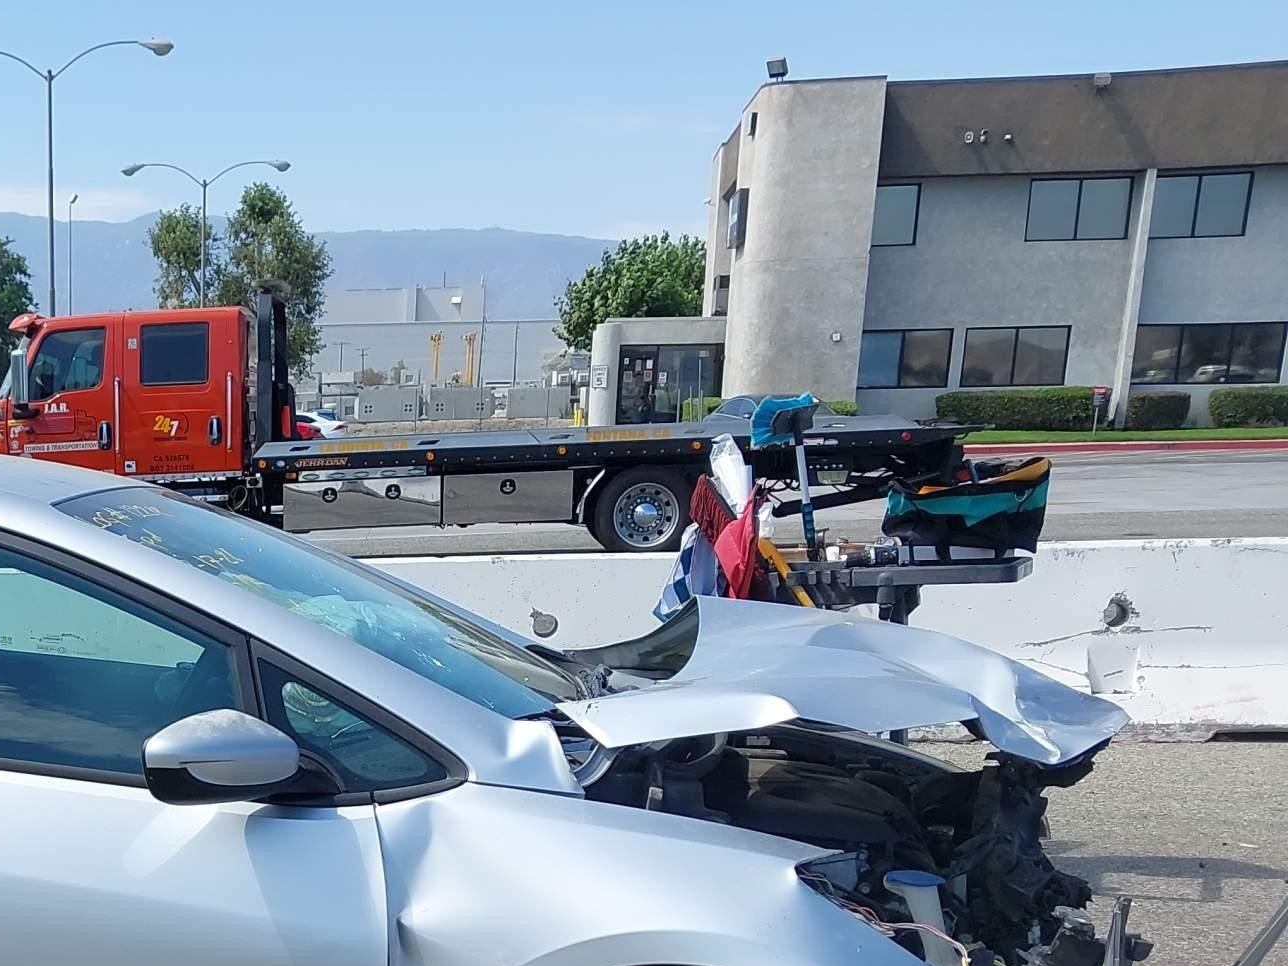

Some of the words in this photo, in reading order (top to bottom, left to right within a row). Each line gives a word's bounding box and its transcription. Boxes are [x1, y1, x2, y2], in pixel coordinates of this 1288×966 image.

[596, 377, 603, 386] 5
[44, 402, 70, 414] J.A.R.
[25, 445, 45, 453] TOWING
[51, 442, 98, 450] TRANSPORTATION
